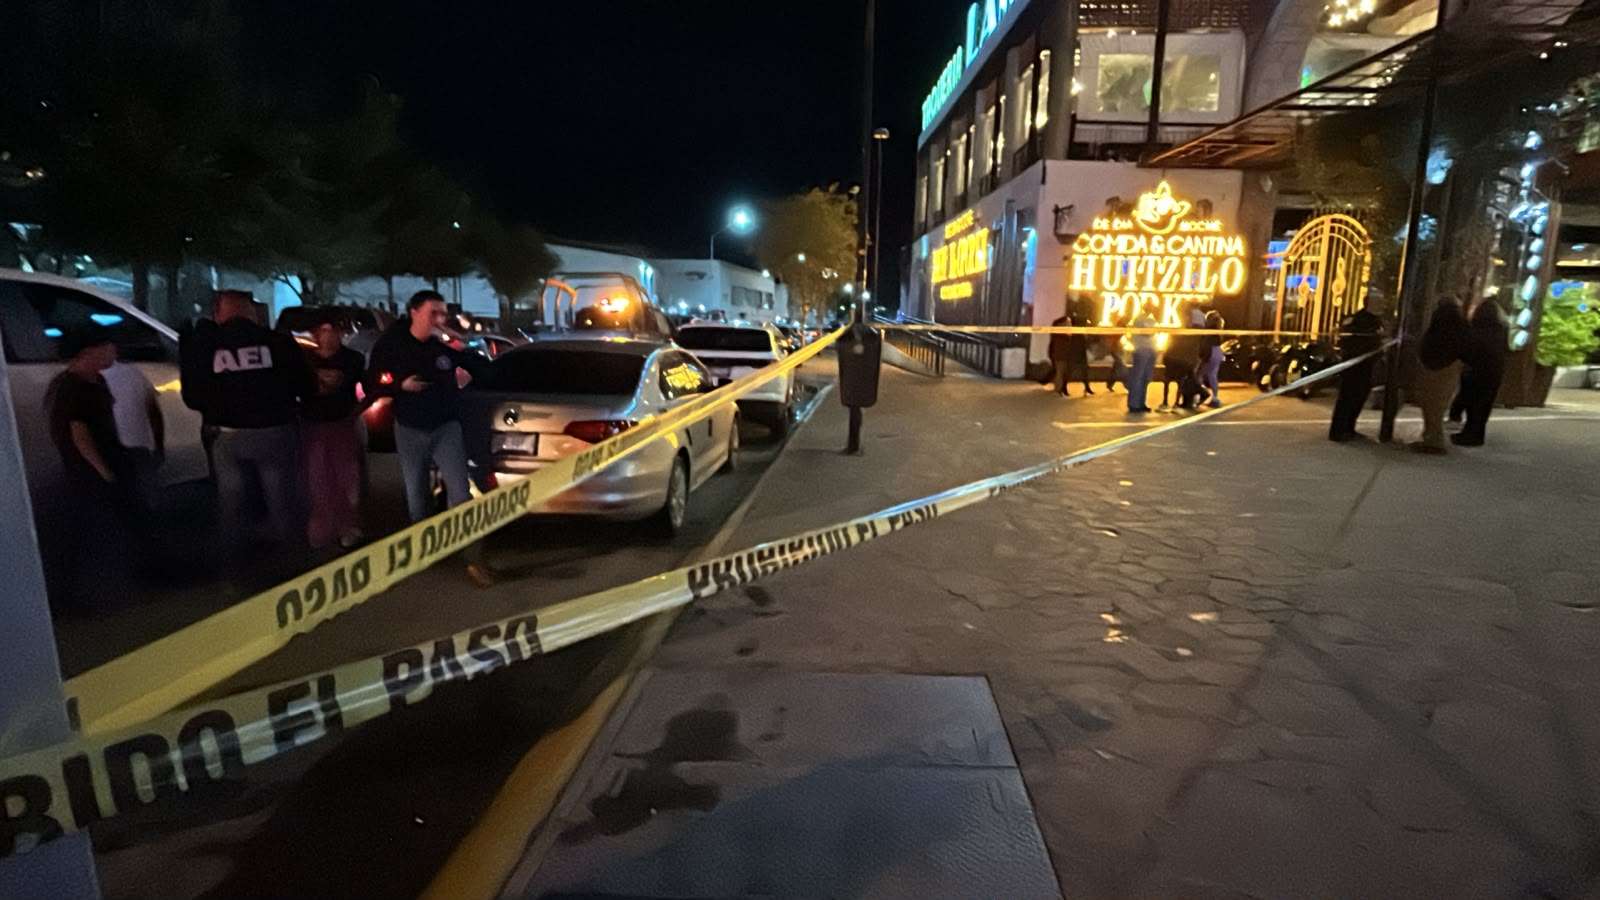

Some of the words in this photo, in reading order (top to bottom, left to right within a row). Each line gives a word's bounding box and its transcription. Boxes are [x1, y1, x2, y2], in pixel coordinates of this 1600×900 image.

[1072, 233, 1148, 255] COMIDA
[1149, 235, 1166, 255] &
[1167, 234, 1245, 256] CANTINA
[1068, 254, 1245, 295] HUITZILO
[213, 345, 273, 373] AEI
